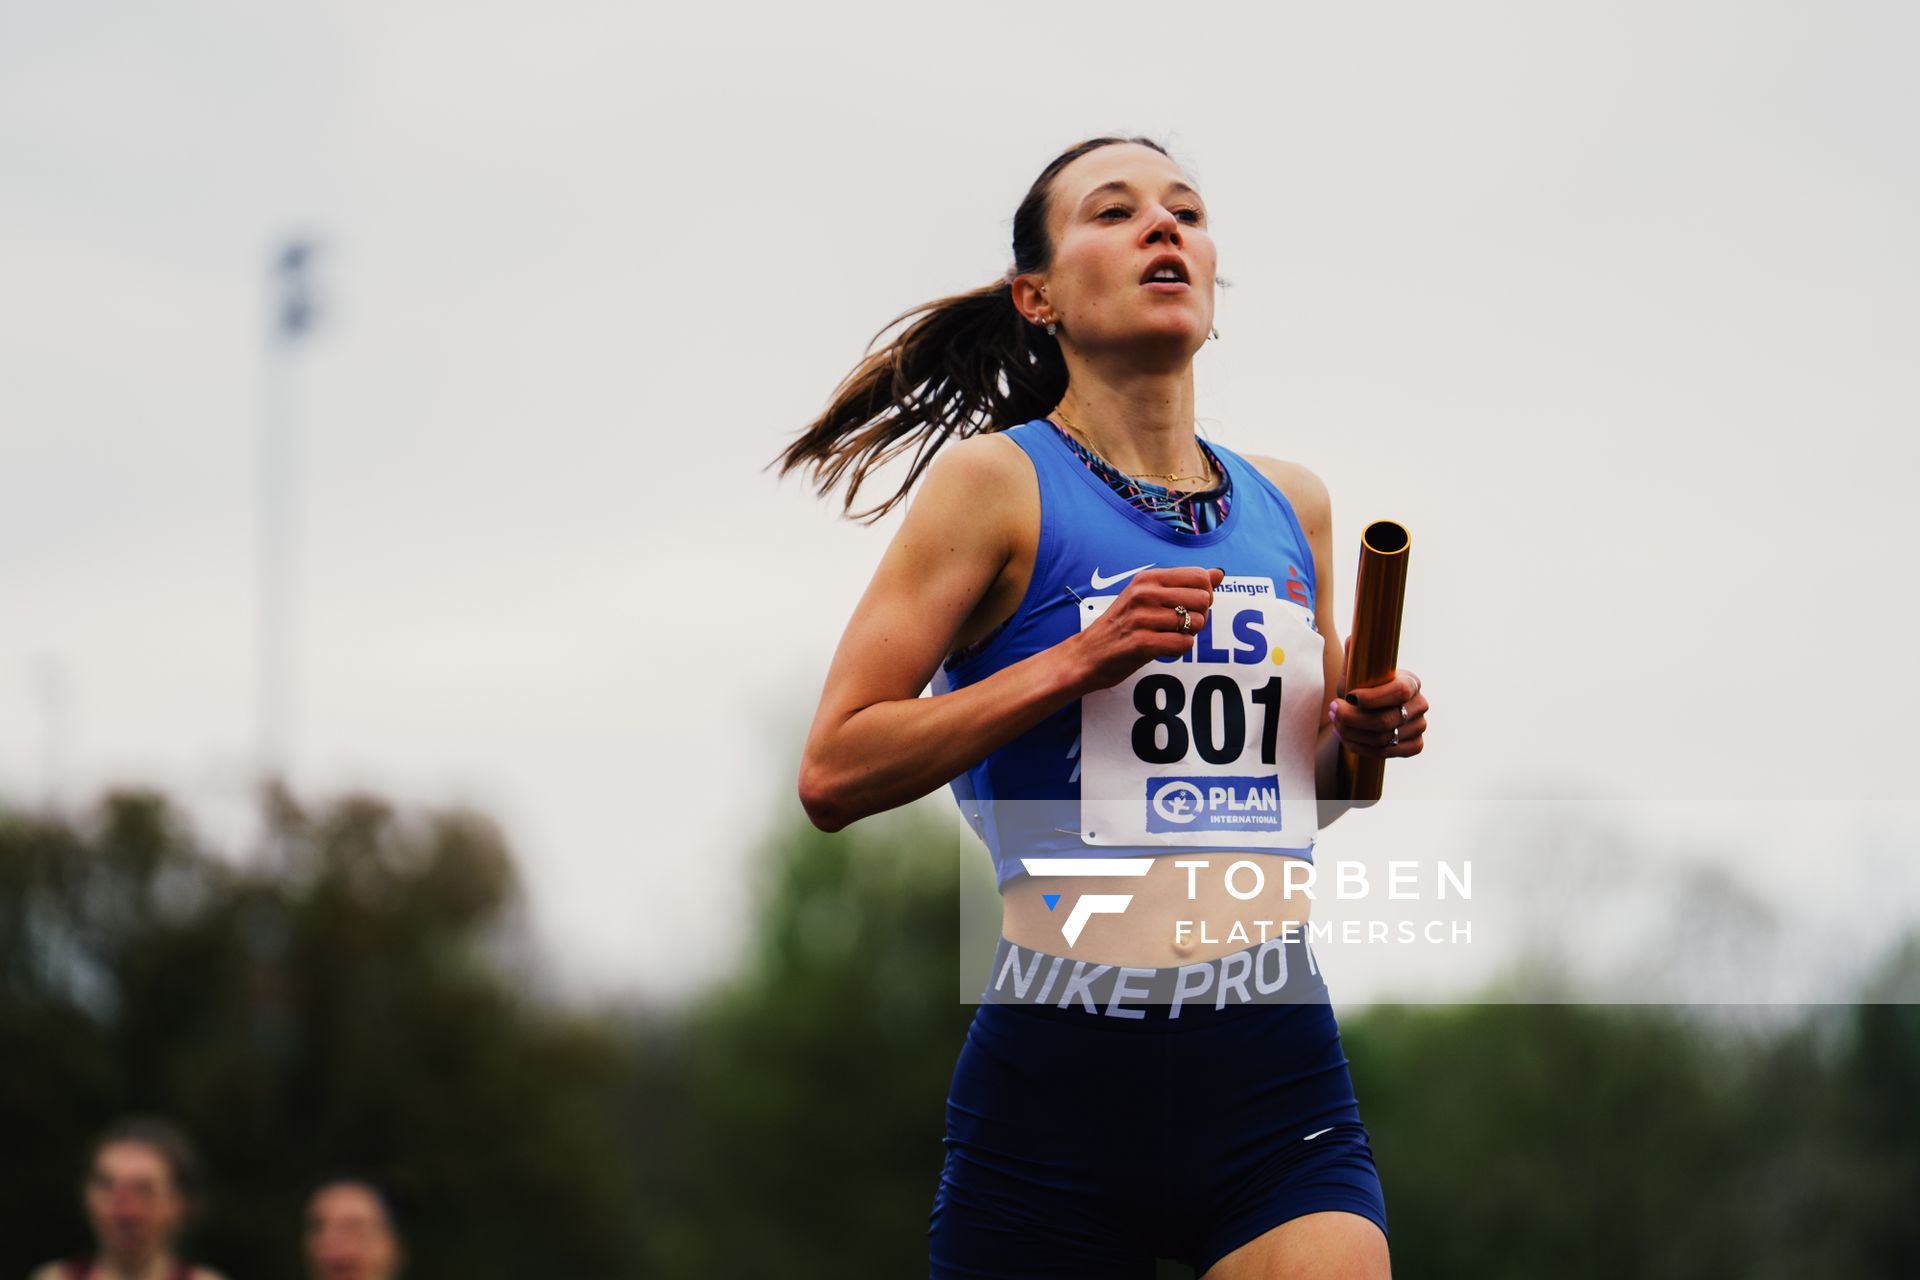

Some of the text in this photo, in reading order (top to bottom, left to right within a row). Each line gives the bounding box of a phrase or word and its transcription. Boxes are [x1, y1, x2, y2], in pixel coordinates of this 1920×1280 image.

[1212, 581, 1270, 596] nsinger
[1154, 609, 1285, 666] LS.
[1131, 673, 1283, 765] 801
[1208, 786, 1278, 812] PLAN
[1210, 815, 1278, 825] INTERNATIONAL
[994, 944, 1157, 1020] NIKE
[1168, 938, 1289, 1020] PRO
